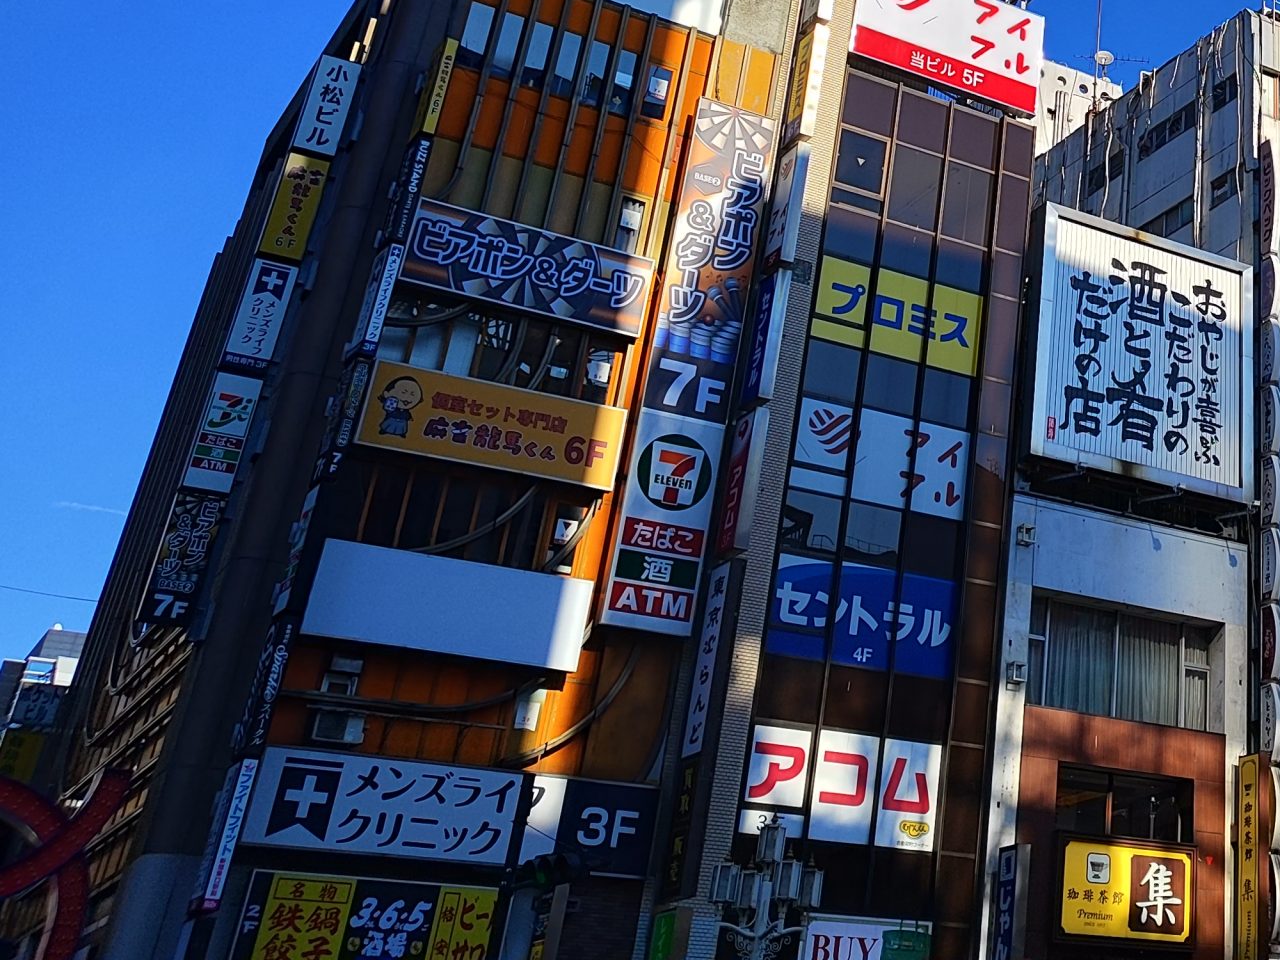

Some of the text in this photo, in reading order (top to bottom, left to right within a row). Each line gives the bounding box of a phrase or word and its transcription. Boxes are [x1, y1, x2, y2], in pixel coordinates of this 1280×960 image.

[910, 51, 985, 88] 当ビル 5F
[306, 64, 349, 147] 小松ビル
[408, 162, 425, 193] STAND
[713, 149, 766, 271] ビアポン
[275, 236, 297, 249] 6F
[413, 216, 645, 308] ビアポン&ダーツ
[668, 201, 716, 324] &ダーツ
[239, 297, 263, 345] クリニック
[253, 300, 276, 356] メンズライフ
[831, 282, 970, 349] プロミス
[362, 342, 377, 354] 3F
[1059, 271, 1114, 437] だけの店
[1105, 257, 1168, 453] 酒と肴
[658, 357, 725, 414] 7F
[1163, 290, 1197, 456] こだわりの
[1192, 279, 1227, 467] おやじが喜ぶ
[431, 390, 568, 435] 個室セット専門店
[200, 459, 227, 472] ATM
[563, 435, 608, 469] 6F
[630, 522, 694, 553] たばこ
[640, 556, 672, 583] 酒
[153, 593, 190, 619] 7F
[615, 586, 688, 619] ATM
[776, 581, 952, 648] セントラル
[853, 648, 873, 663] 4F
[748, 742, 931, 815] アコム
[336, 808, 502, 856] クリニック
[576, 806, 640, 850] 3F
[289, 882, 338, 901] 名物
[1136, 862, 1183, 927] 集
[268, 903, 341, 937] 鉄鍋
[1076, 908, 1114, 922] Premium
[812, 934, 878, 960] BUY
